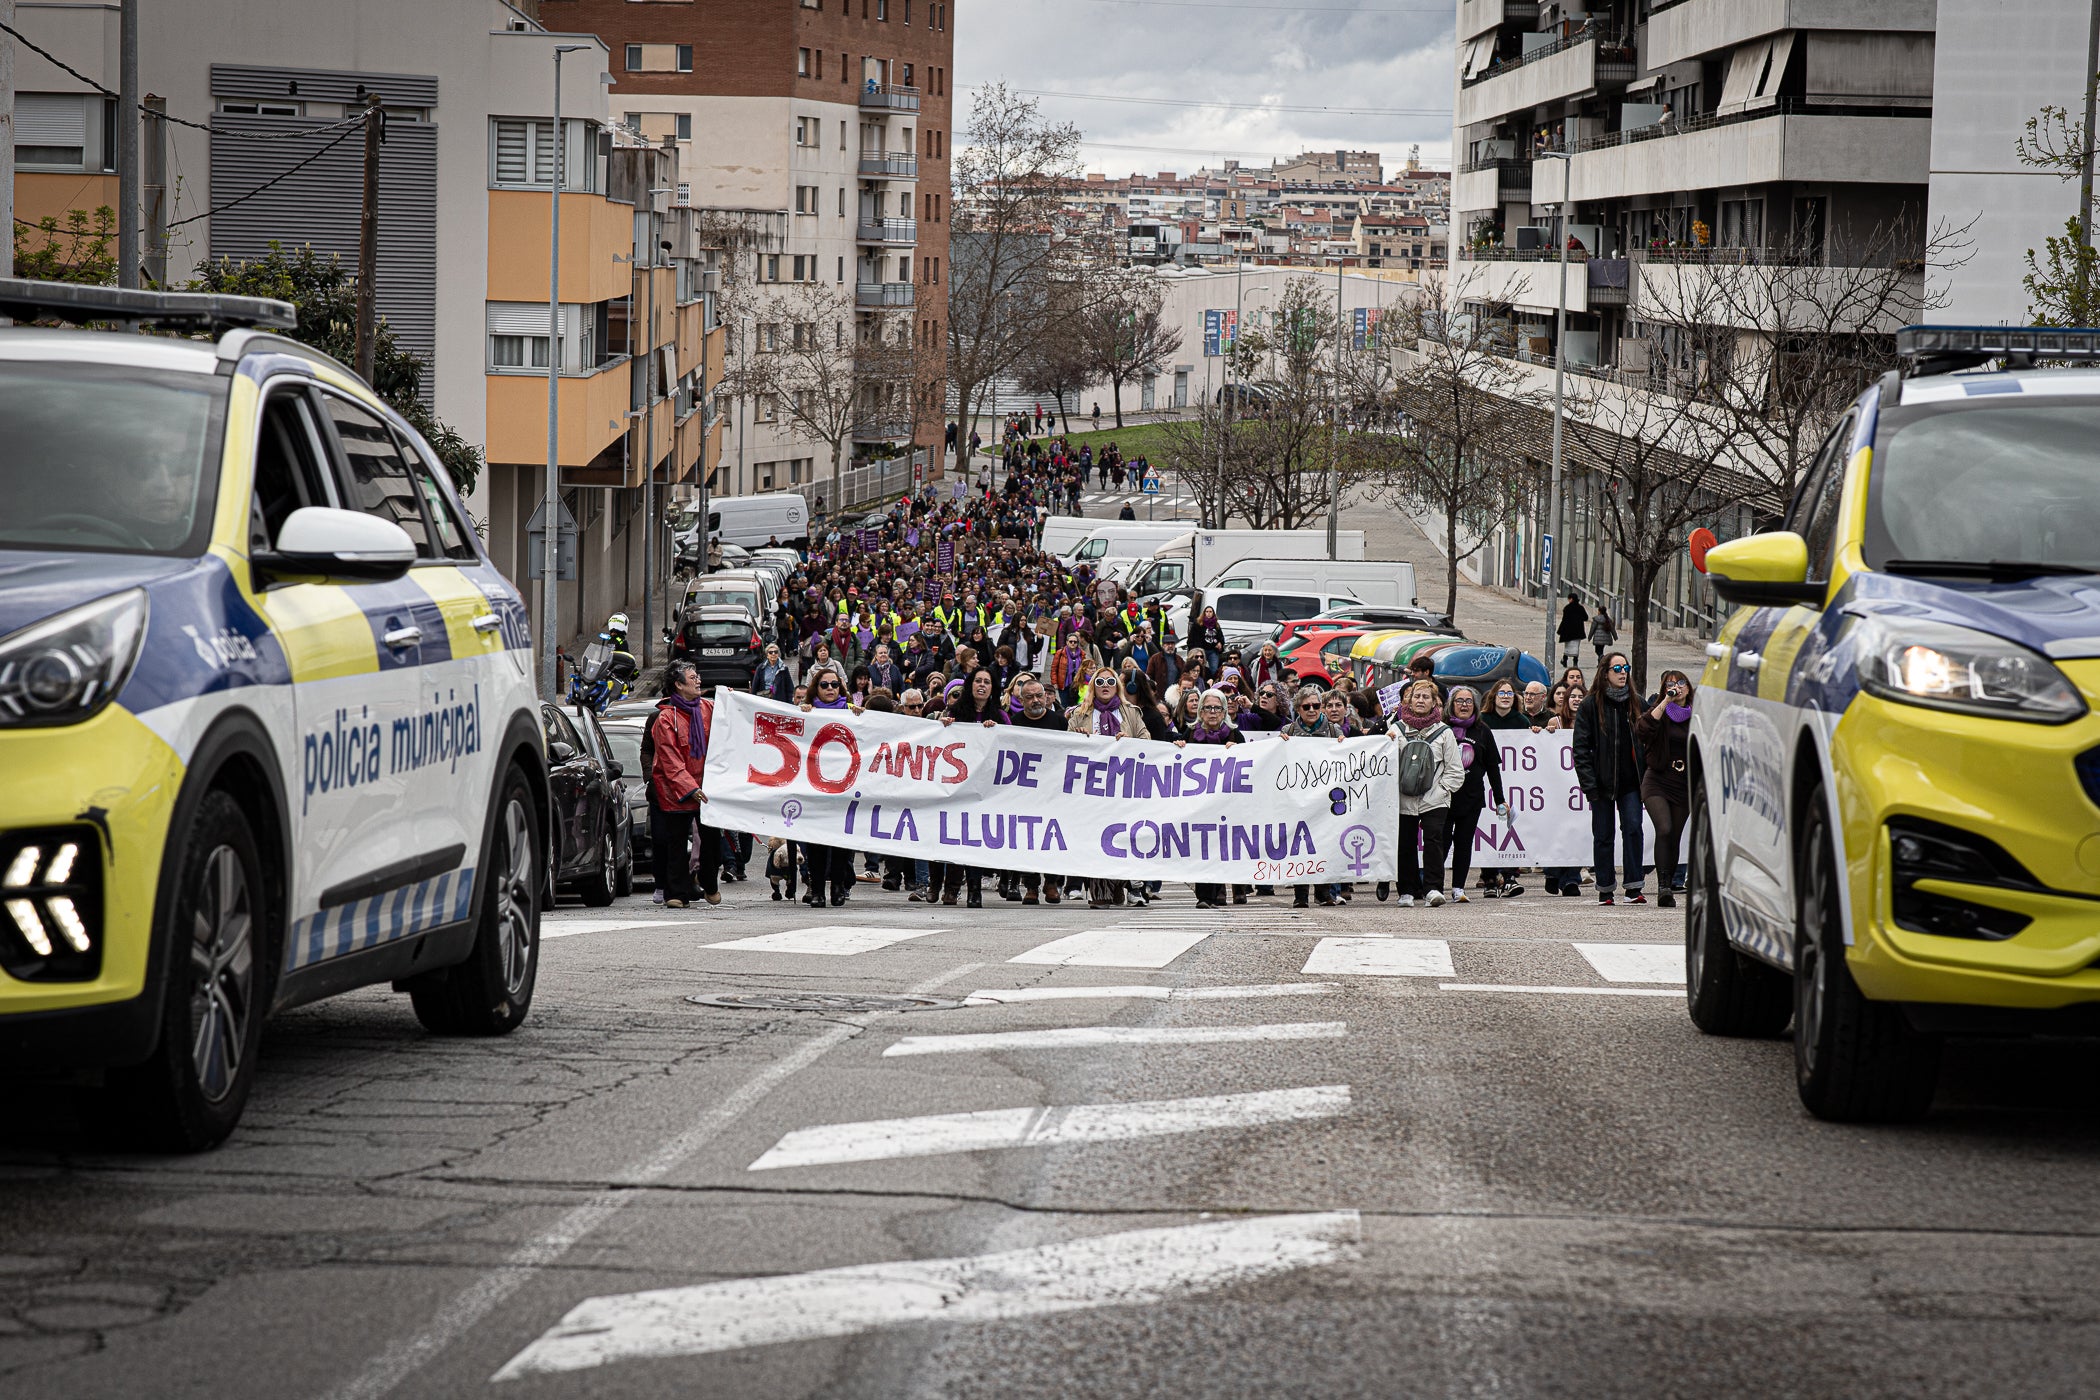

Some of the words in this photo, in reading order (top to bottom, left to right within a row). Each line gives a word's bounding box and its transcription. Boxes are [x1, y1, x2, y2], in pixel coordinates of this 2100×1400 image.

[1544, 538, 1550, 567] P
[303, 705, 381, 816] policia
[390, 684, 481, 775] municipal
[748, 712, 861, 794] 50
[868, 742, 969, 784] ANYS
[993, 750, 1042, 788] DE
[1276, 750, 1392, 791] assemblea
[870, 804, 919, 841] LA
[939, 811, 1068, 850] LLUITA
[1286, 860, 1327, 879] 2026
